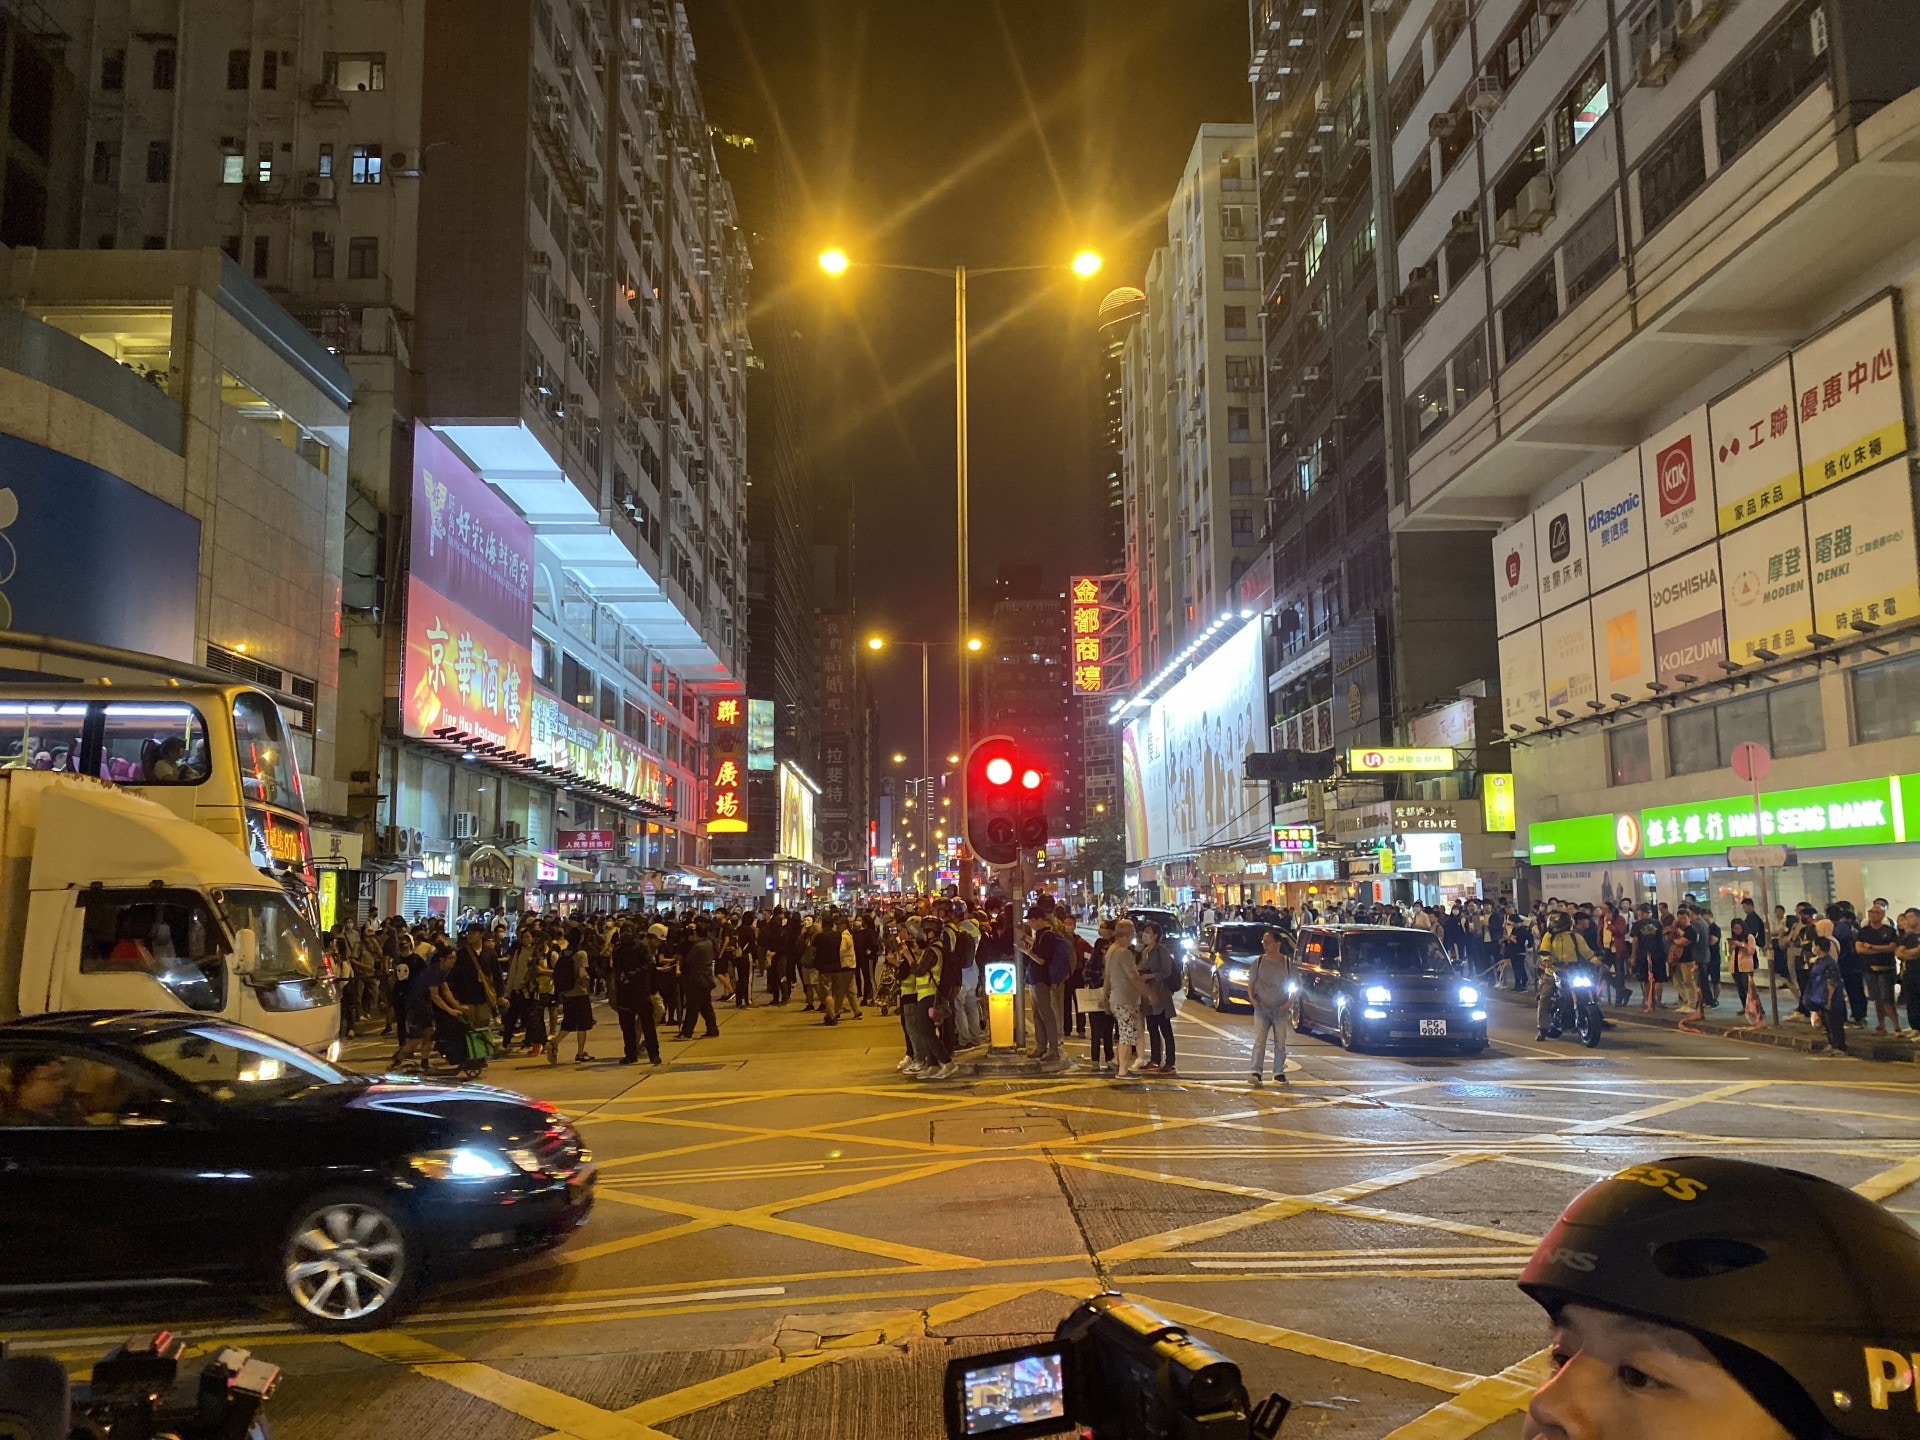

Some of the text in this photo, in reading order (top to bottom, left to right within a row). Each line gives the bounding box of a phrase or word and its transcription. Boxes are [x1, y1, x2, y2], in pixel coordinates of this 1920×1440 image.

[1748, 347, 1894, 451] 工聯優惠中心
[1665, 461, 1687, 492] KDK
[1595, 492, 1640, 529] Rasonic
[1734, 484, 1784, 521] 家品床品
[456, 503, 529, 592] 好彩海鮮酒家
[1652, 567, 1719, 609] DOSHISHA
[1762, 562, 1850, 604] MODERN DENKI
[426, 615, 521, 730] 京華酒樓
[1658, 636, 1723, 673] KOIZUMI
[458, 715, 473, 735] Hua
[1776, 804, 1827, 835] SENG
[1828, 799, 1887, 831] BANK
[1421, 1027, 1445, 1036] 9890
[1426, 1020, 1440, 1028] PG
[1863, 1346, 1920, 1414] P
